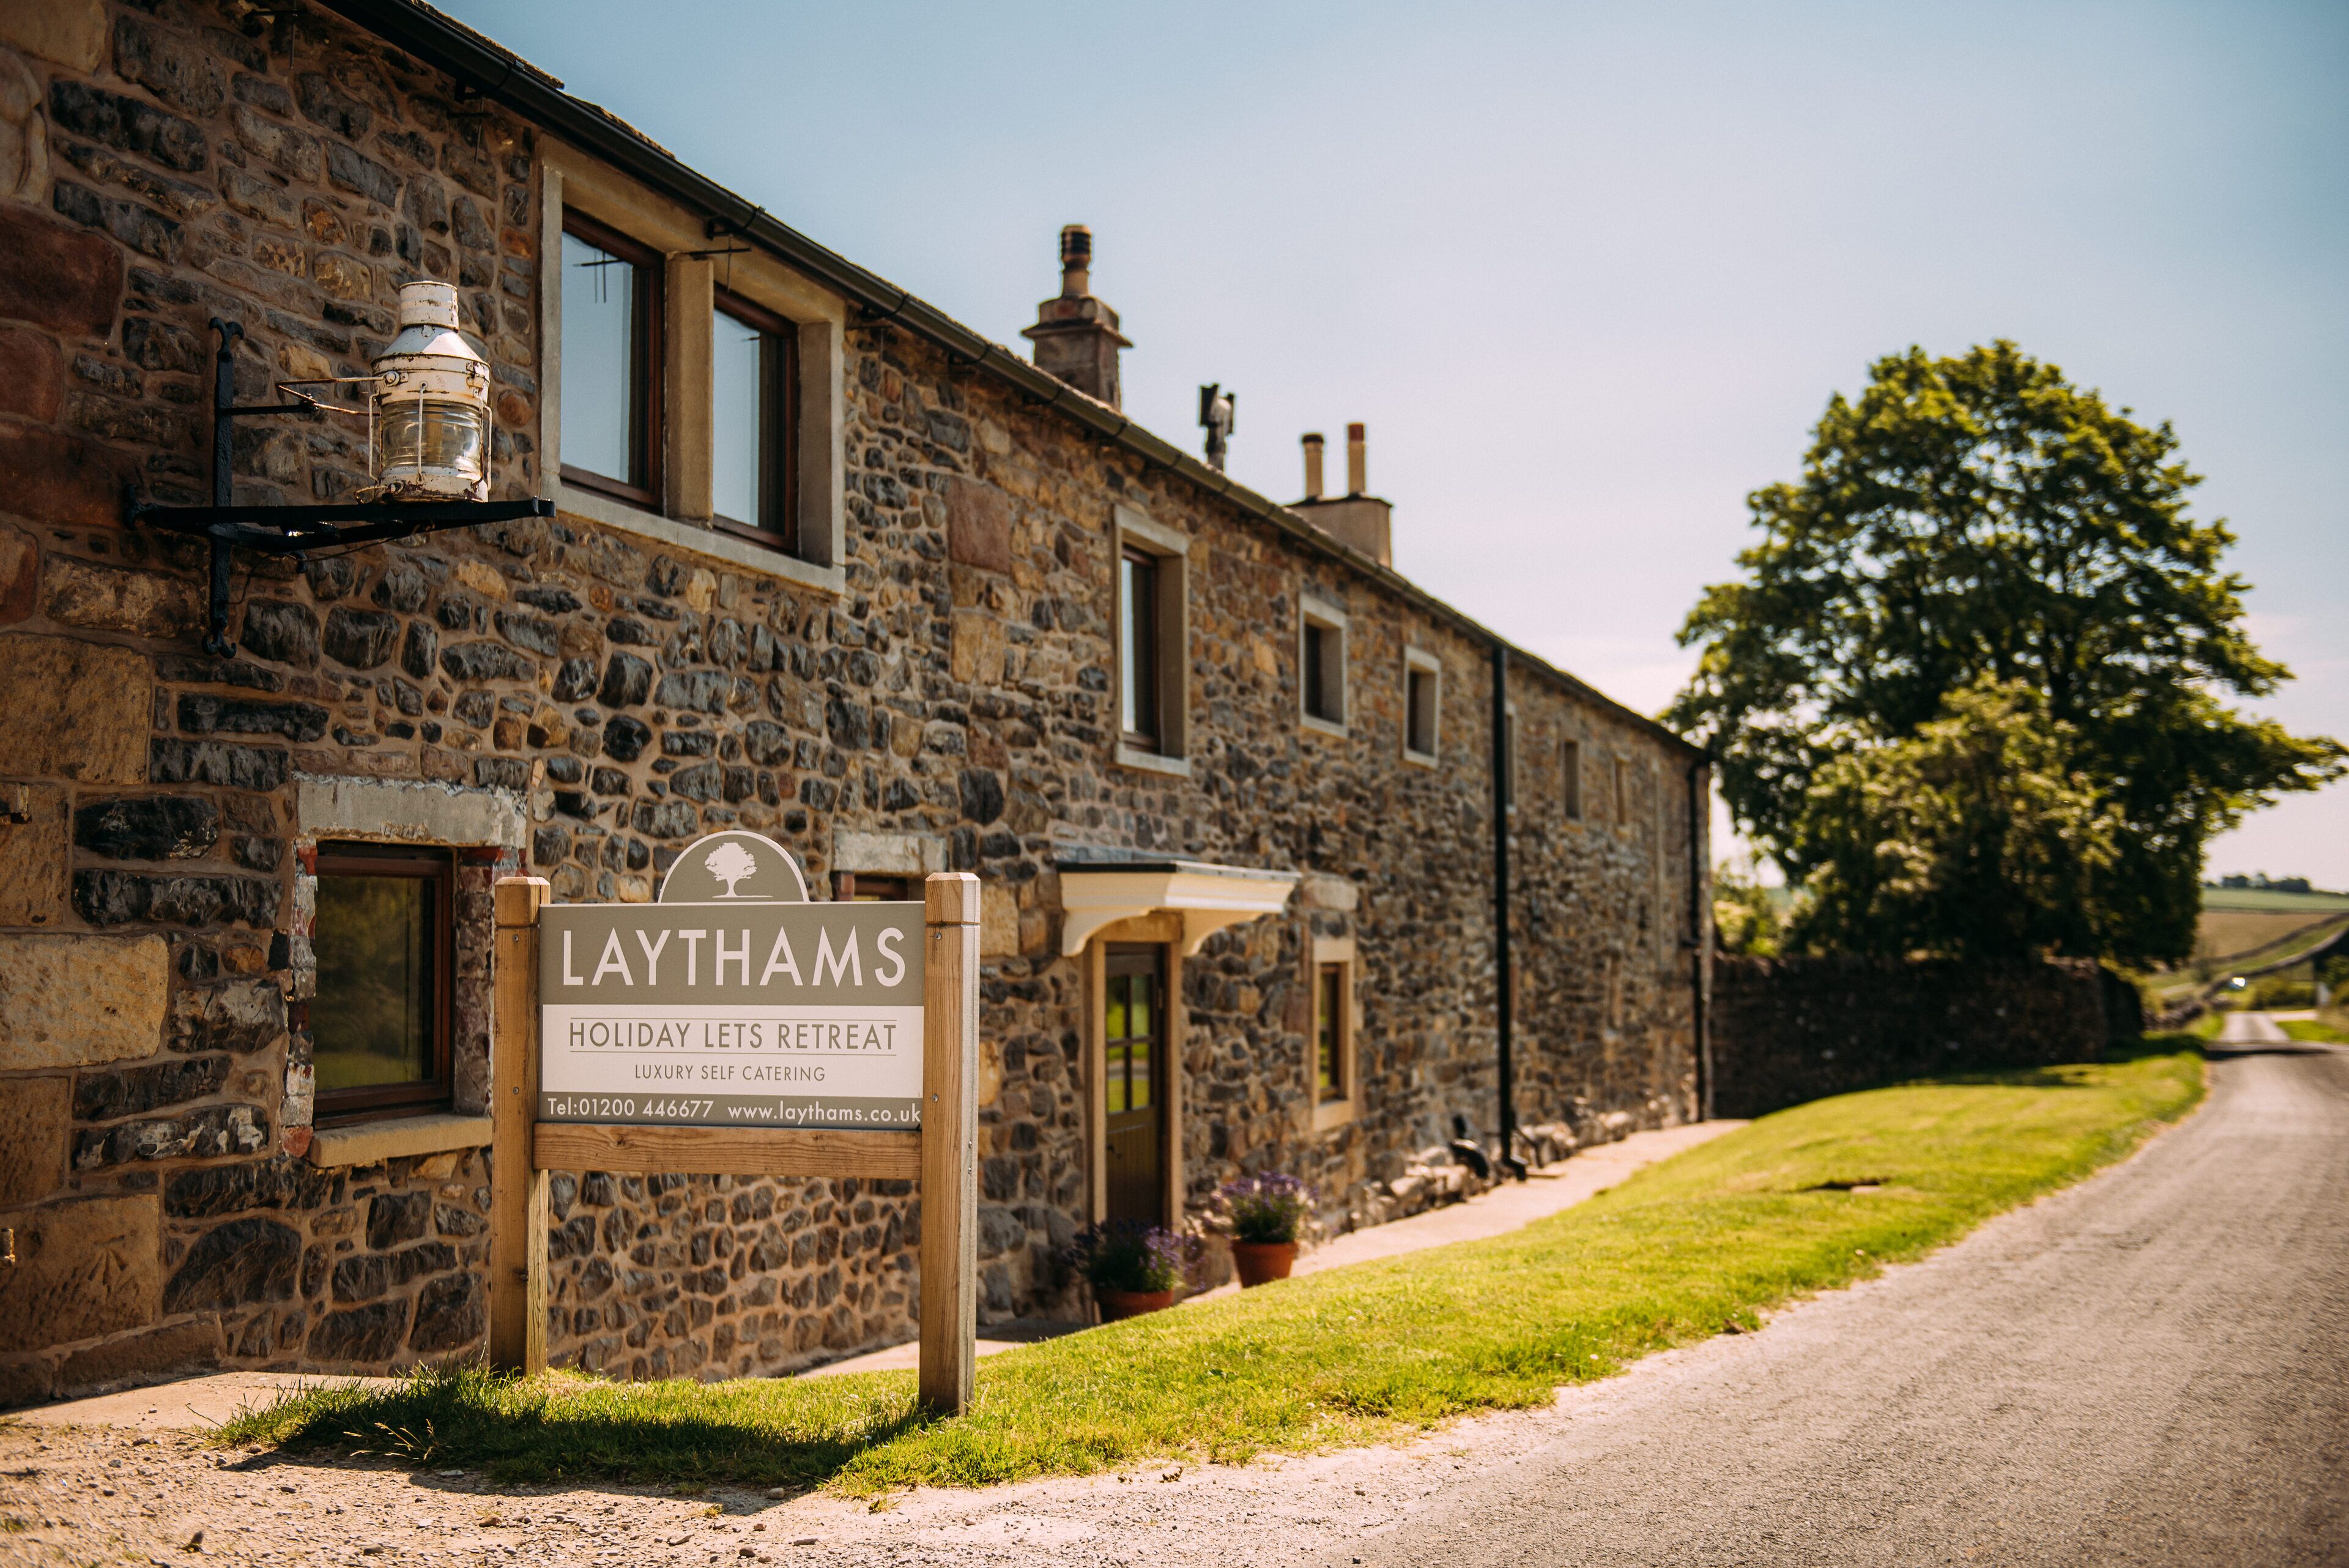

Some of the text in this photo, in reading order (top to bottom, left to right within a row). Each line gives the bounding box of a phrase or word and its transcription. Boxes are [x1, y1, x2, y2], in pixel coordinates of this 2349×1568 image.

[563, 925, 906, 988] LAYTHAMS
[570, 1022, 897, 1050] HOLIDAY LETS RETREAT
[635, 1065, 826, 1082] LUXURY SELF CATERING
[547, 1096, 921, 1125] Tel:01200 446677 www.laythams.co.uk
